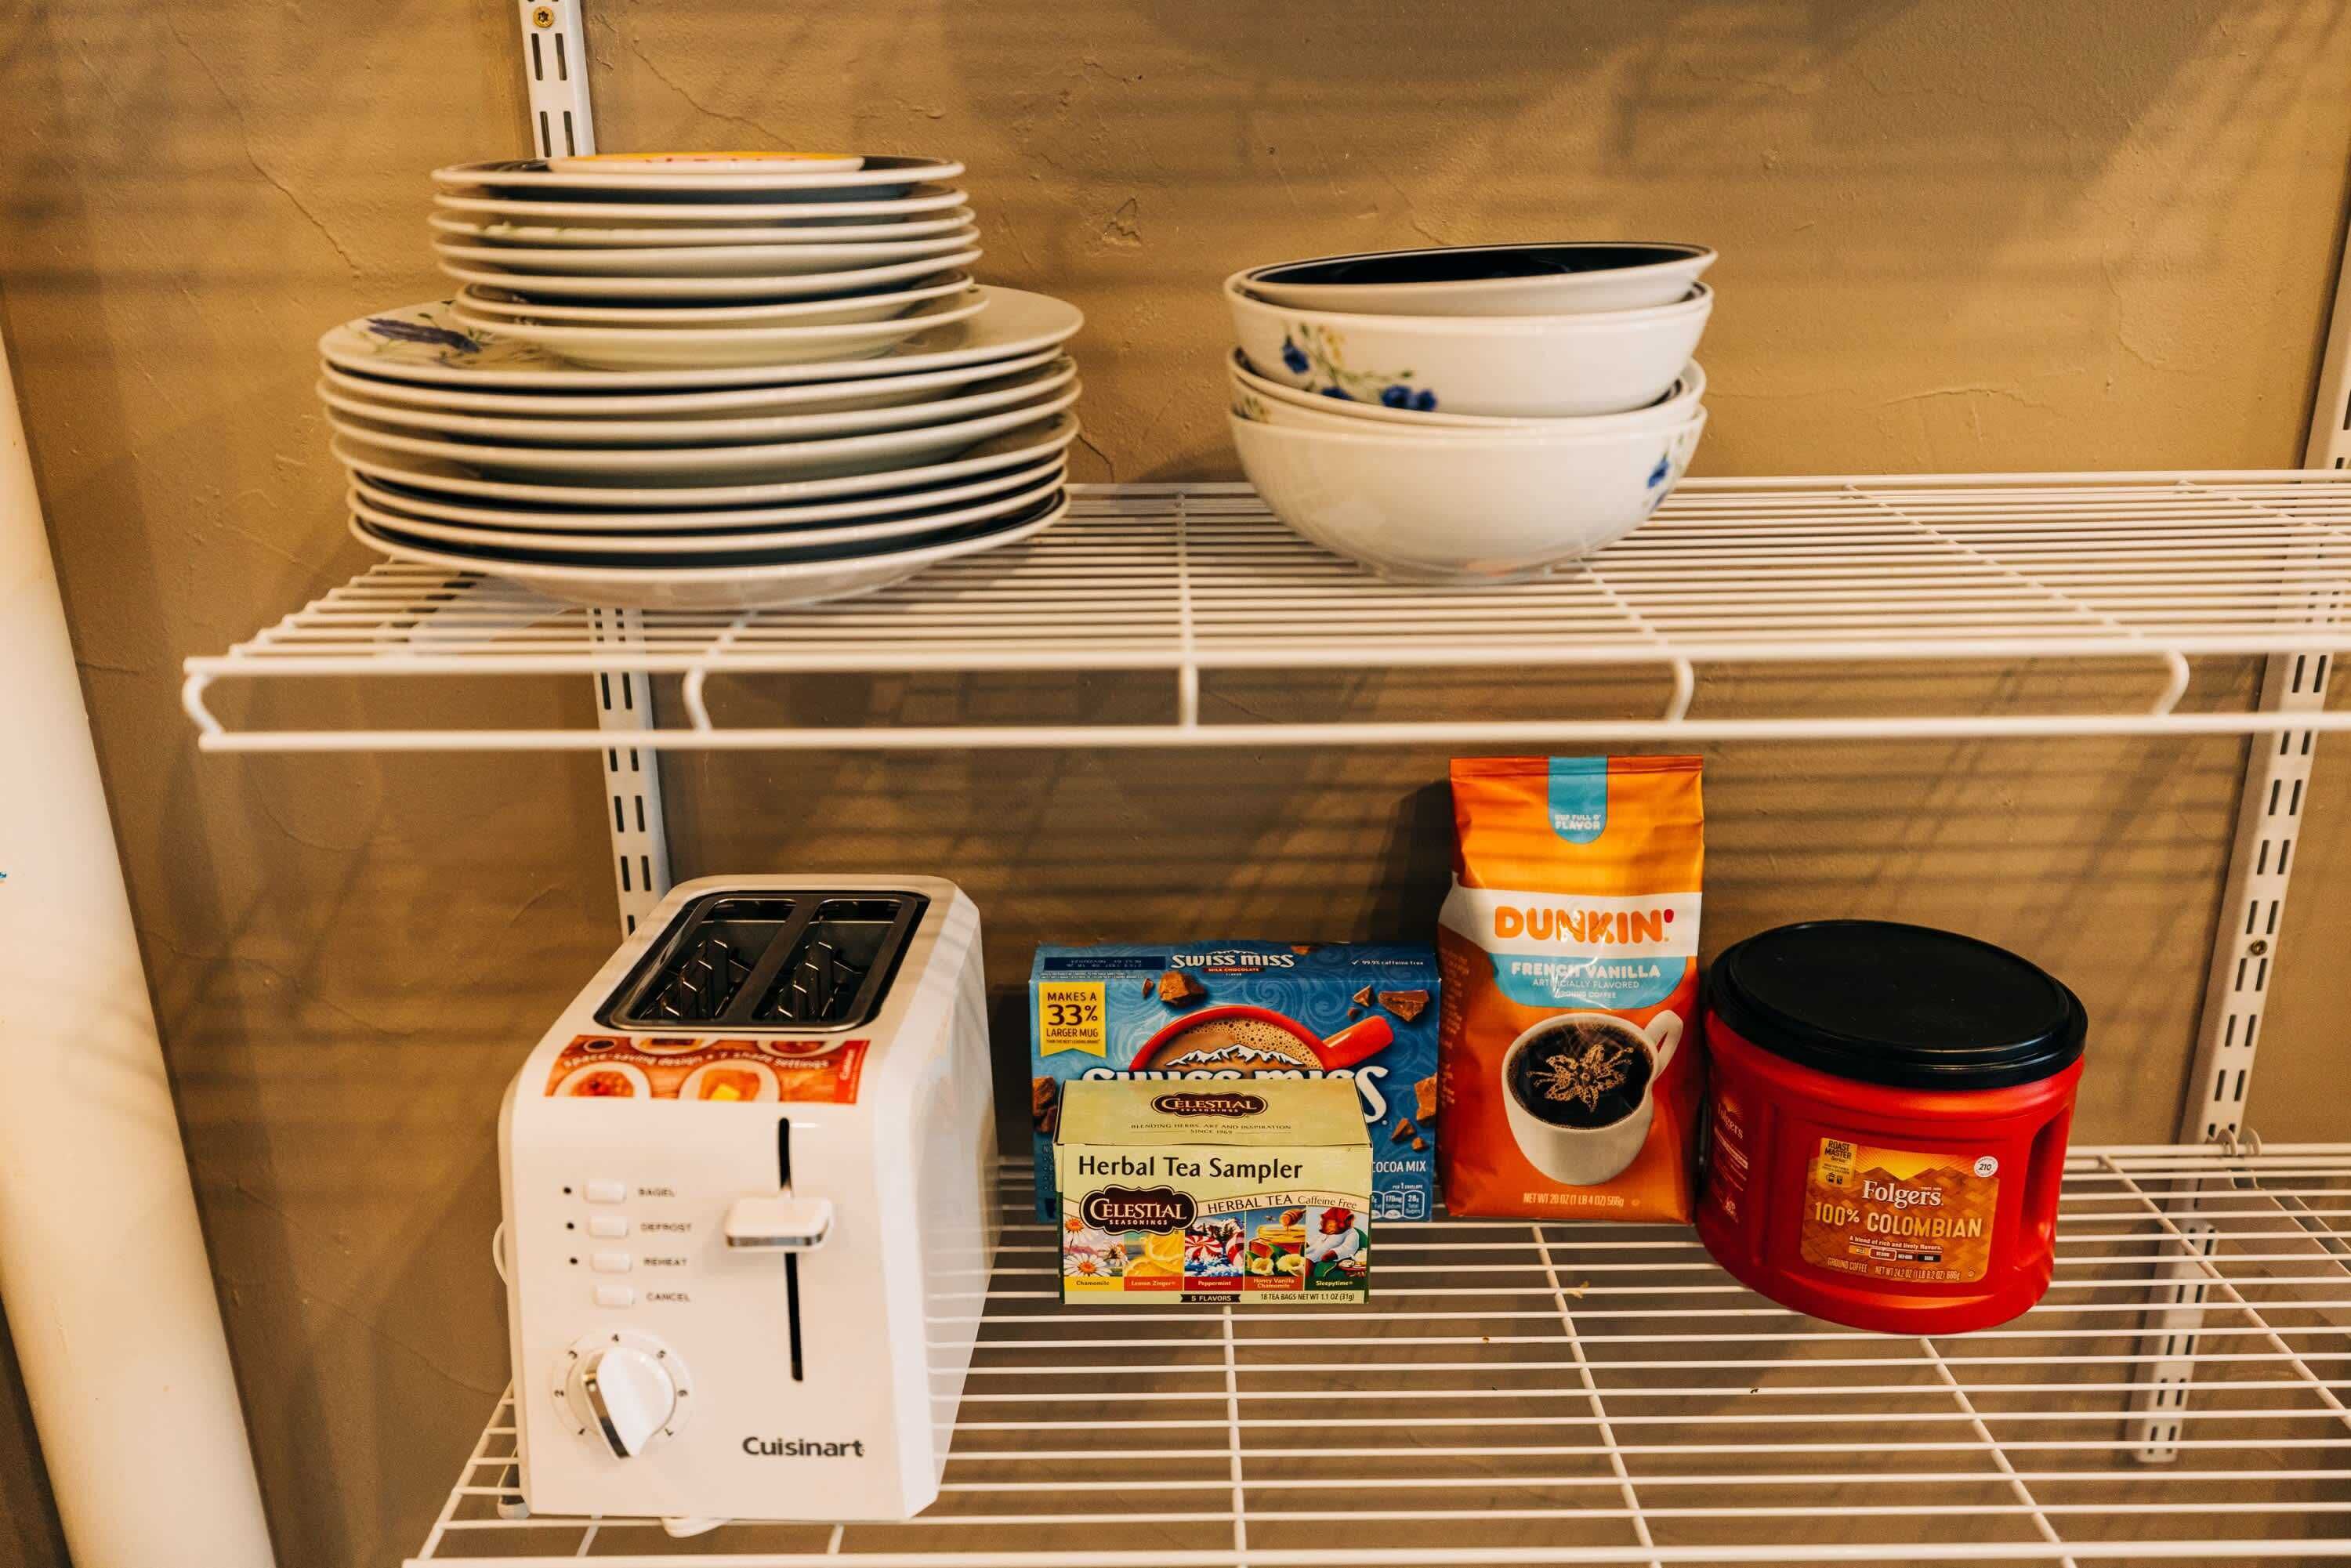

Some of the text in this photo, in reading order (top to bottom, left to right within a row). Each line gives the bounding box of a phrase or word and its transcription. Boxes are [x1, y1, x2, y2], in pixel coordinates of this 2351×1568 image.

[1555, 820, 1601, 831] FLAVOR
[1494, 906, 1674, 945] DUNKIN'
[1511, 961, 1661, 979] FRENCH VANILLA
[1593, 980, 1639, 989] FLAVORED
[1047, 992, 1097, 1001] MAKES A
[1047, 1004, 1098, 1026] 33%
[1046, 1028, 1099, 1037] LARGER MUG
[1161, 1097, 1257, 1110] CELESTIAL
[1828, 1140, 1850, 1151] ROAST
[1825, 1147, 1852, 1160] MASTER
[1079, 1156, 1303, 1184] Herbal Tea Sampler
[1406, 1161, 1426, 1172] MIX
[639, 1188, 676, 1197] BAGEL
[1523, 1193, 1536, 1204] NET
[1862, 1180, 1943, 1209] Folgers
[1090, 1198, 1187, 1220] CELESTIAL
[1208, 1194, 1357, 1214] HERBAL TEA Caffeine Free
[1814, 1201, 1982, 1238] 100% COLOMBIAN
[640, 1222, 692, 1233] DEFROST
[643, 1258, 687, 1266] REHEAT
[1827, 1257, 1849, 1270] GROUND
[1849, 1261, 1868, 1273] COFFEE
[646, 1293, 690, 1302] CANCEL
[742, 1436, 863, 1458] Cuisinart
